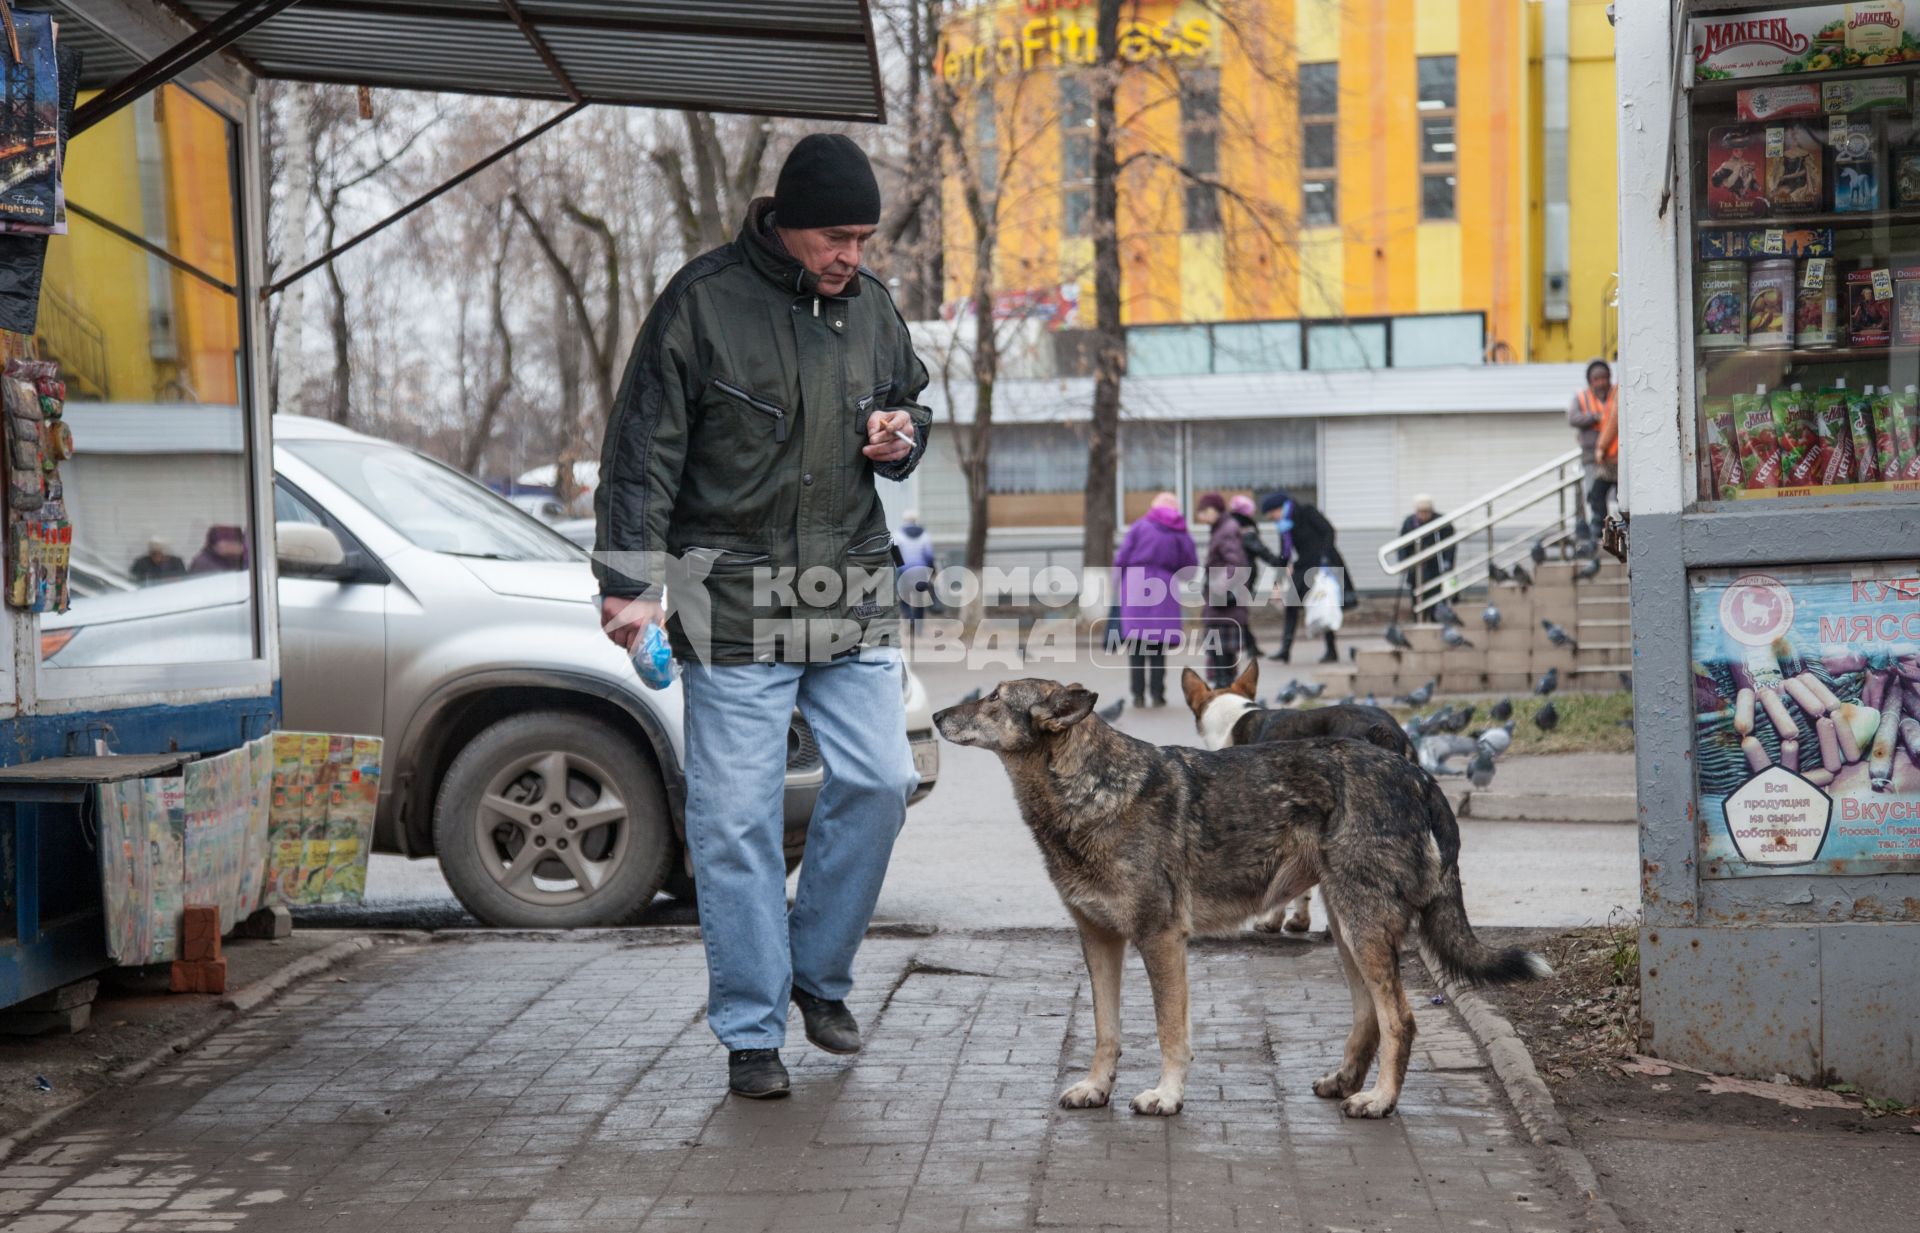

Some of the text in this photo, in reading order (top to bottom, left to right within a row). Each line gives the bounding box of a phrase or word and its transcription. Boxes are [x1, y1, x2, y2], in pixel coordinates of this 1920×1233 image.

[25, 206, 44, 217] city
[1764, 782, 1788, 793] Вся
[1744, 799, 1810, 811] продукция
[1750, 813, 1806, 824] из сырья
[1736, 827, 1821, 838] собственного
[1760, 843, 1797, 853] забоя
